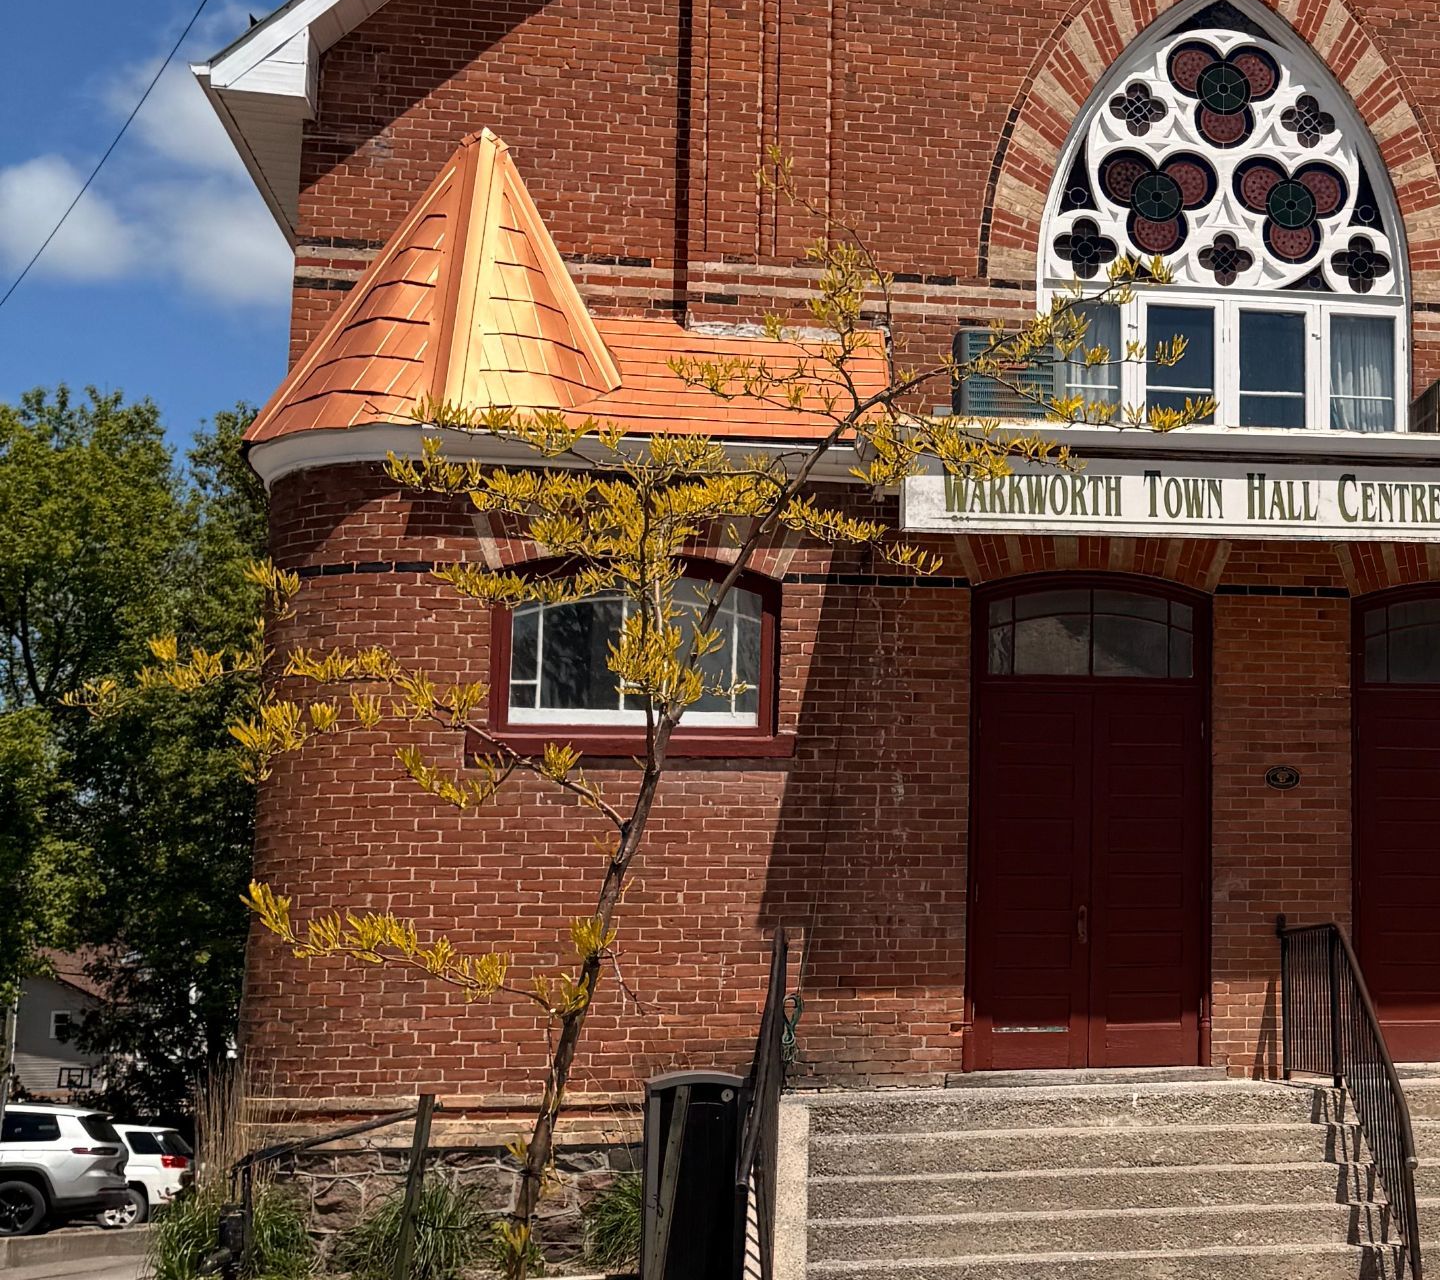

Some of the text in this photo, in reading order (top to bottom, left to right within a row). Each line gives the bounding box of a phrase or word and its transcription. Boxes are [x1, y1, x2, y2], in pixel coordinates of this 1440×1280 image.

[943, 463, 1122, 516] WARKWORTH
[1144, 470, 1224, 518] TOWN
[1247, 472, 1318, 521] HALL
